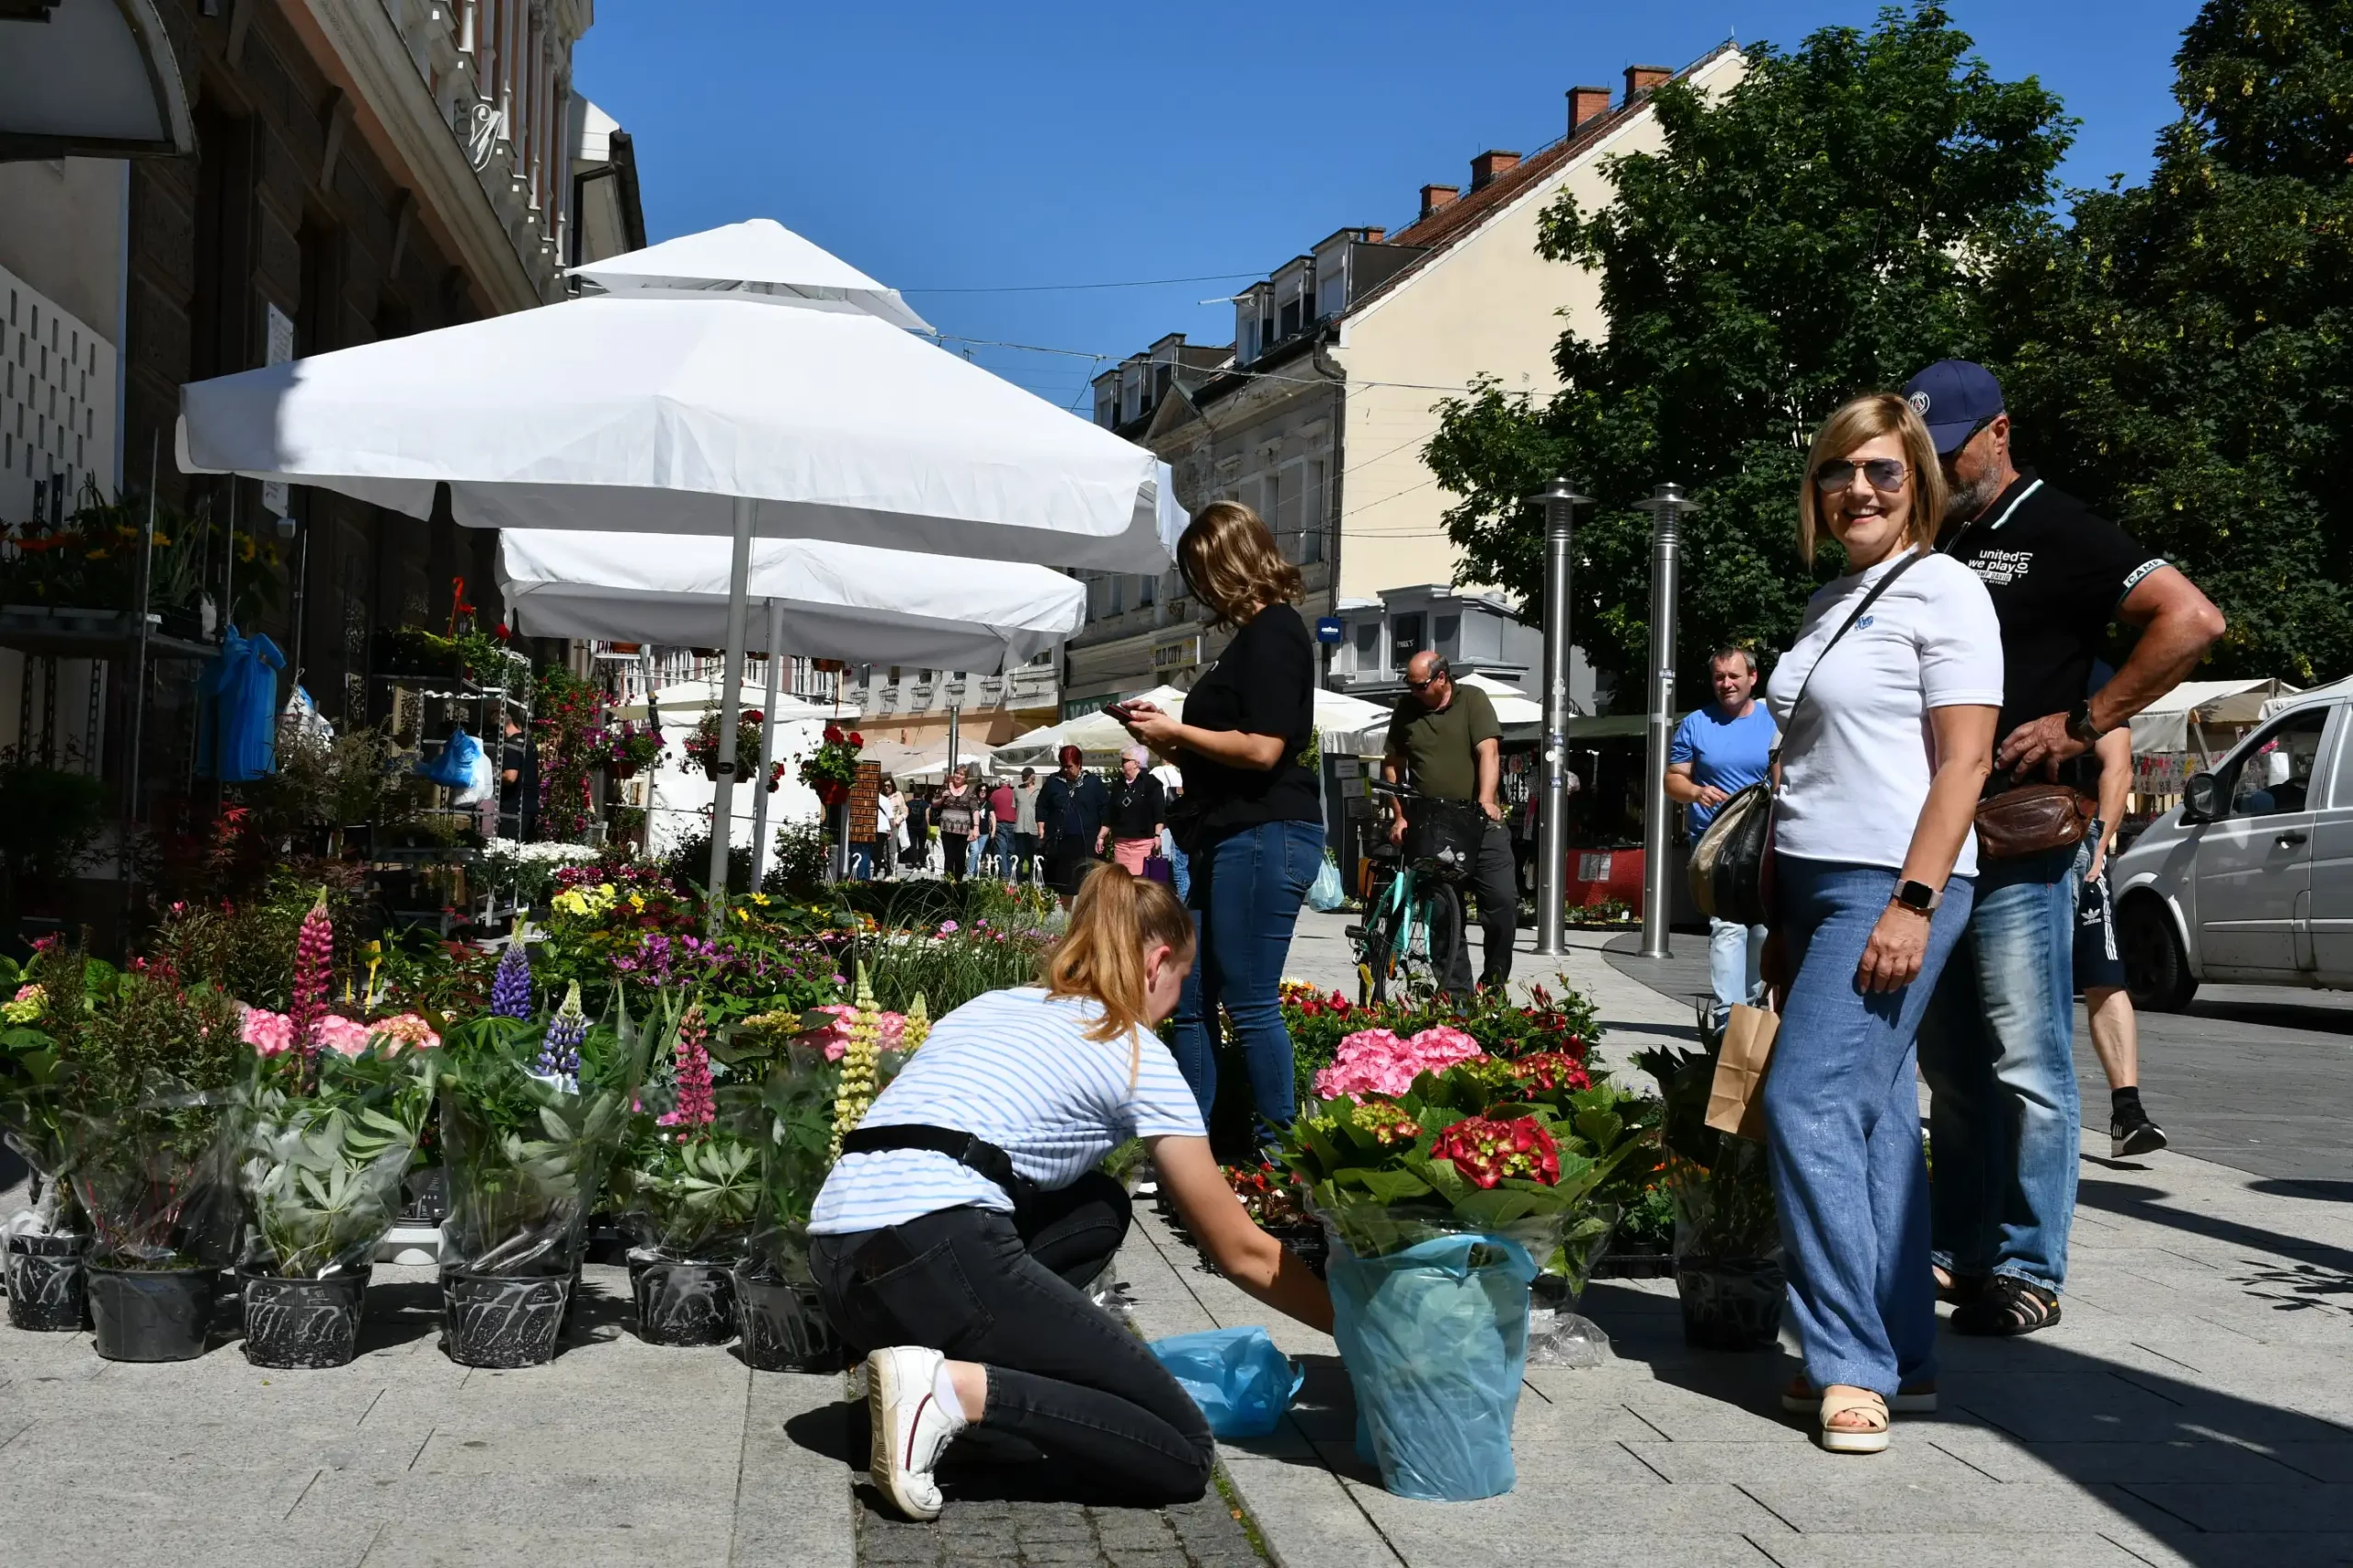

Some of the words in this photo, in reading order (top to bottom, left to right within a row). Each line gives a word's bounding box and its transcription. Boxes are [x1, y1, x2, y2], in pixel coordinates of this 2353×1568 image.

[1979, 549, 2019, 562] united
[1969, 560, 1985, 568] we
[1987, 560, 2016, 574] play
[2128, 561, 2159, 584] CAMP
[1991, 572, 2010, 581] DAVID
[1155, 647, 1166, 667] OLD
[1167, 644, 1182, 665] CITY
